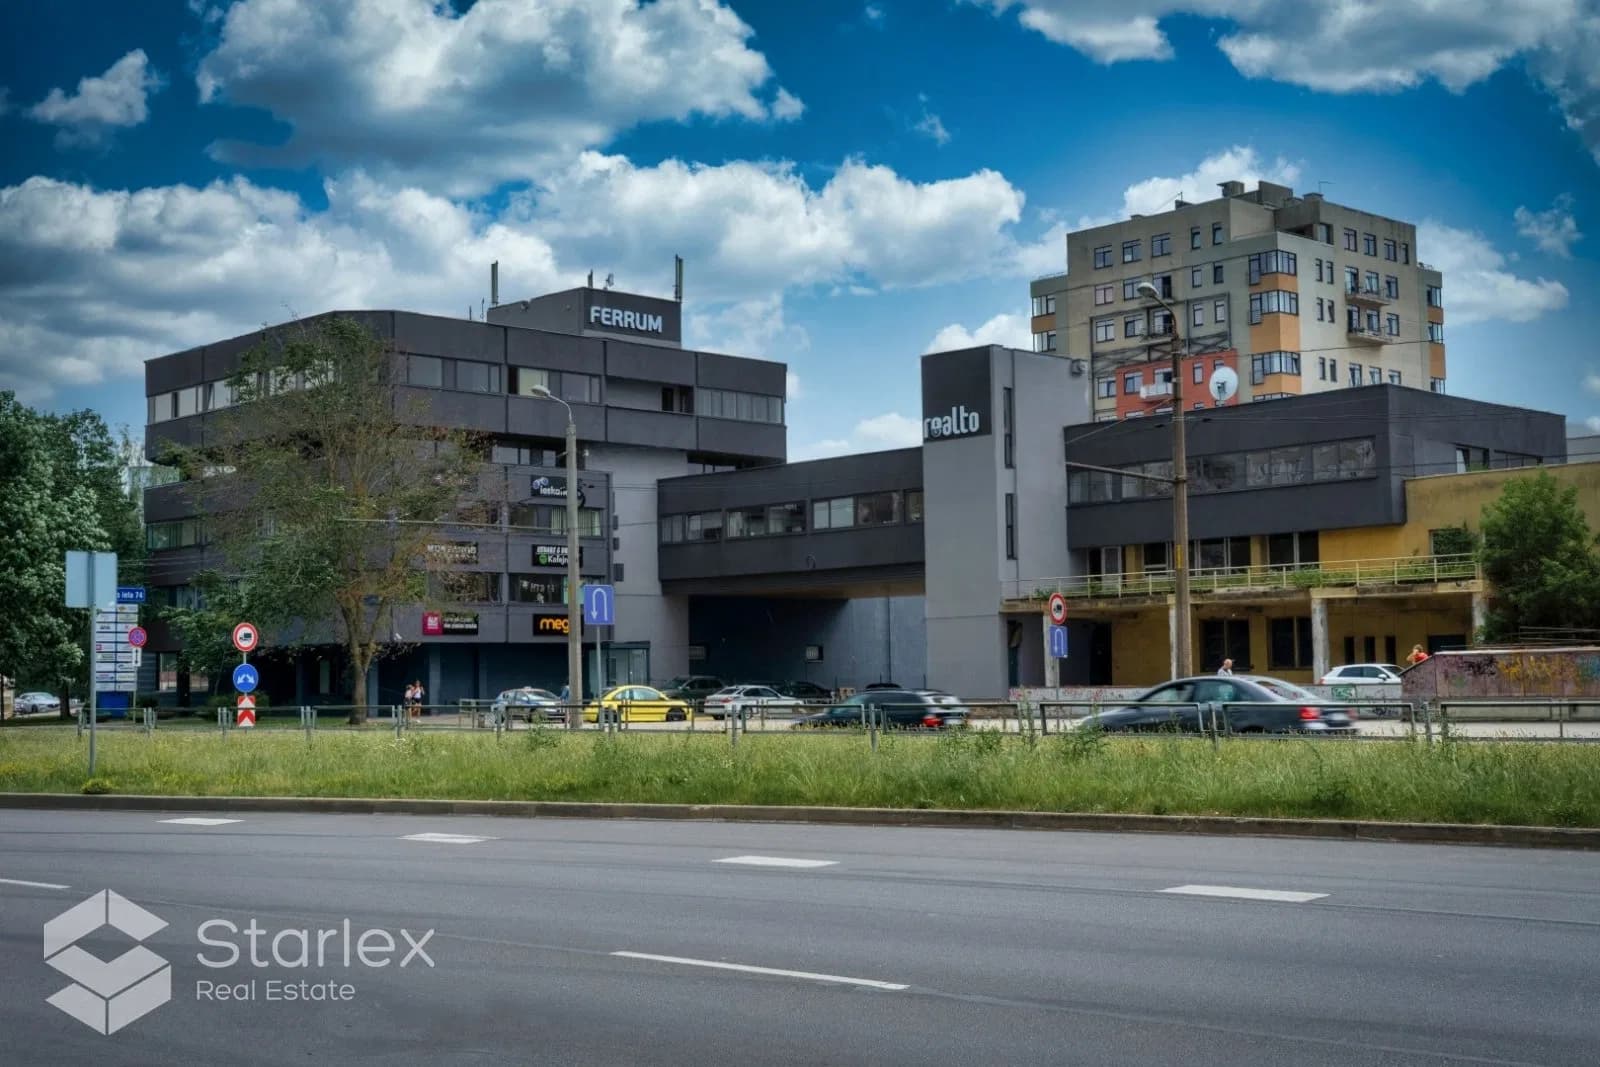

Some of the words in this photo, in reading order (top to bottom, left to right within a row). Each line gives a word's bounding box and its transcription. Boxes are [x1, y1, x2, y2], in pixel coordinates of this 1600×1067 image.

[590, 305, 663, 333] FERRUM
[924, 405, 980, 438] realto
[548, 555, 569, 566] Kafejn
[135, 591, 143, 599] 74
[540, 618, 569, 634] meg
